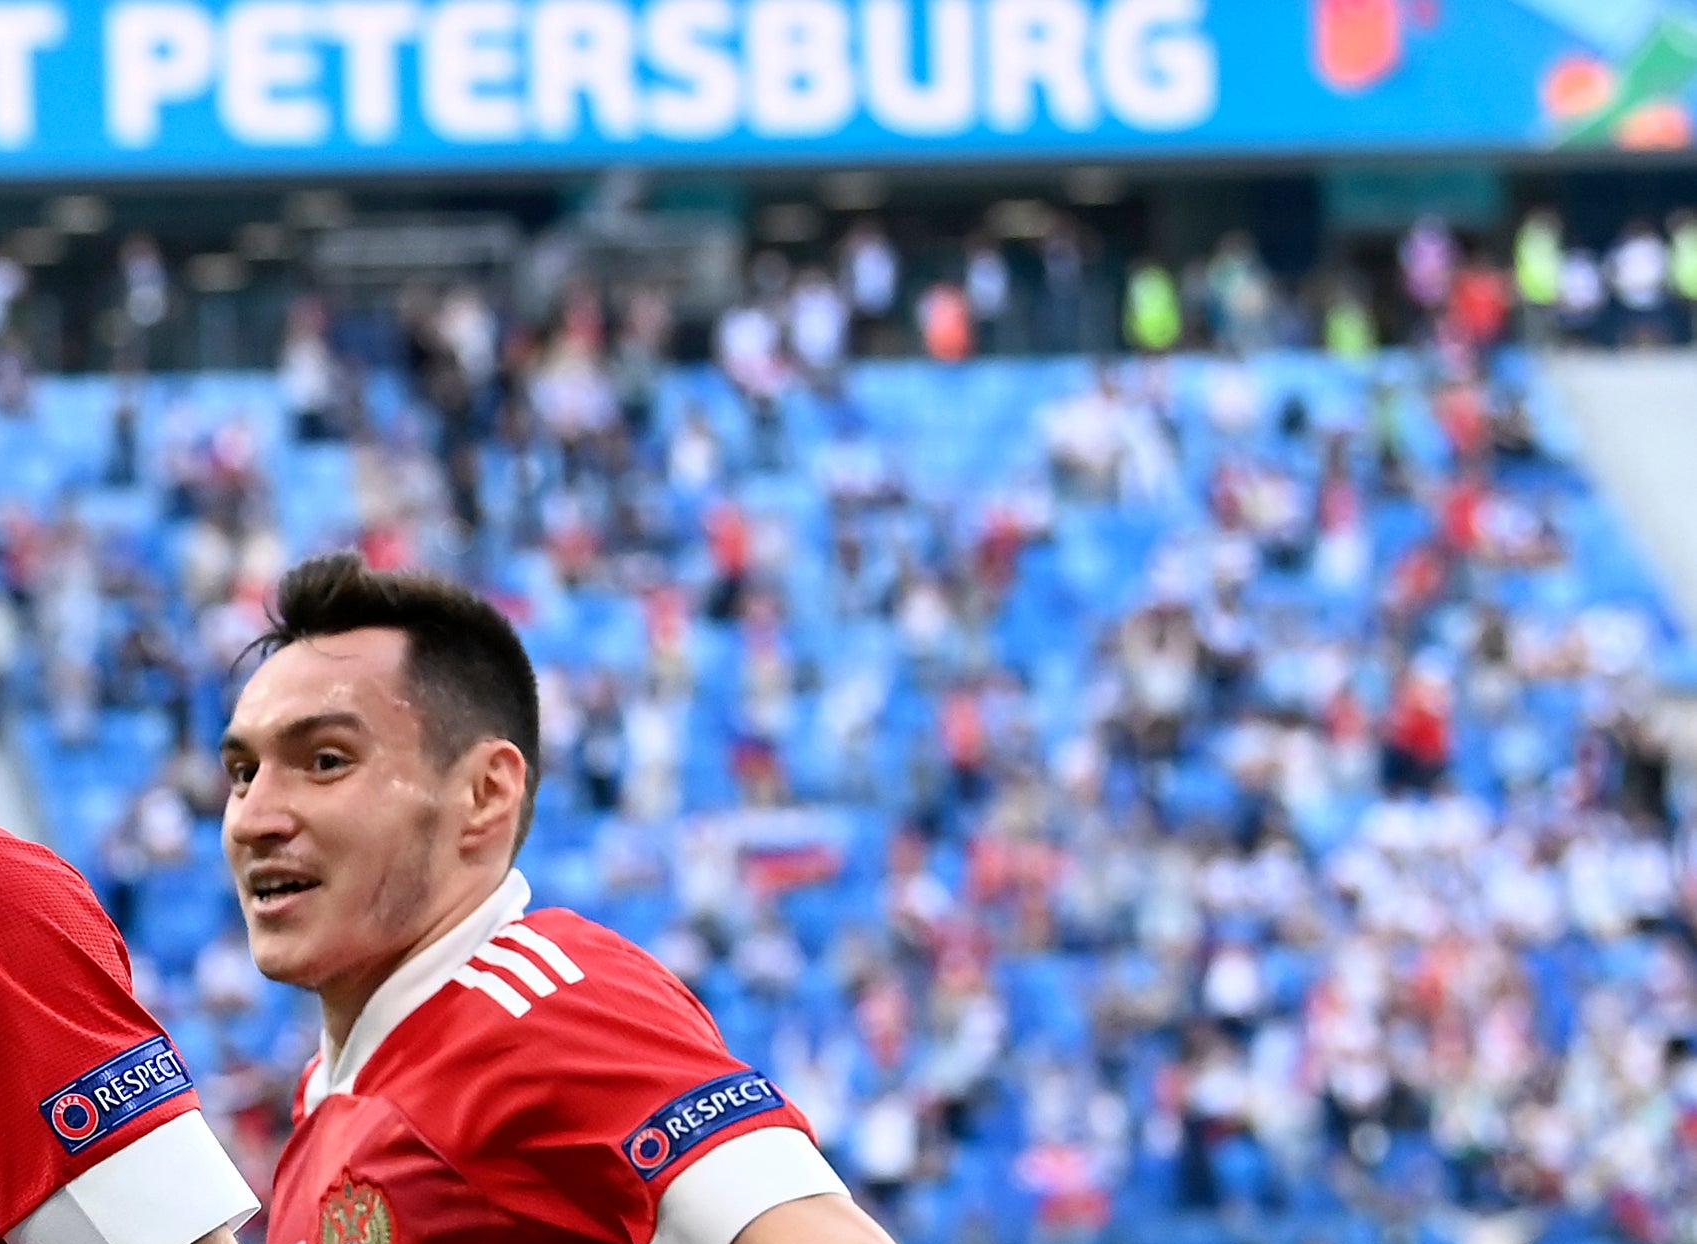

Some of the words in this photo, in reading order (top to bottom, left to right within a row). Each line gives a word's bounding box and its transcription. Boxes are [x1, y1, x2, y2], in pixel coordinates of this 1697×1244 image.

[105, 0, 1219, 148] PETERSBURG
[54, 1096, 80, 1115] UEFA
[93, 1050, 182, 1112] RESPECT
[665, 1078, 773, 1140] RESPECT
